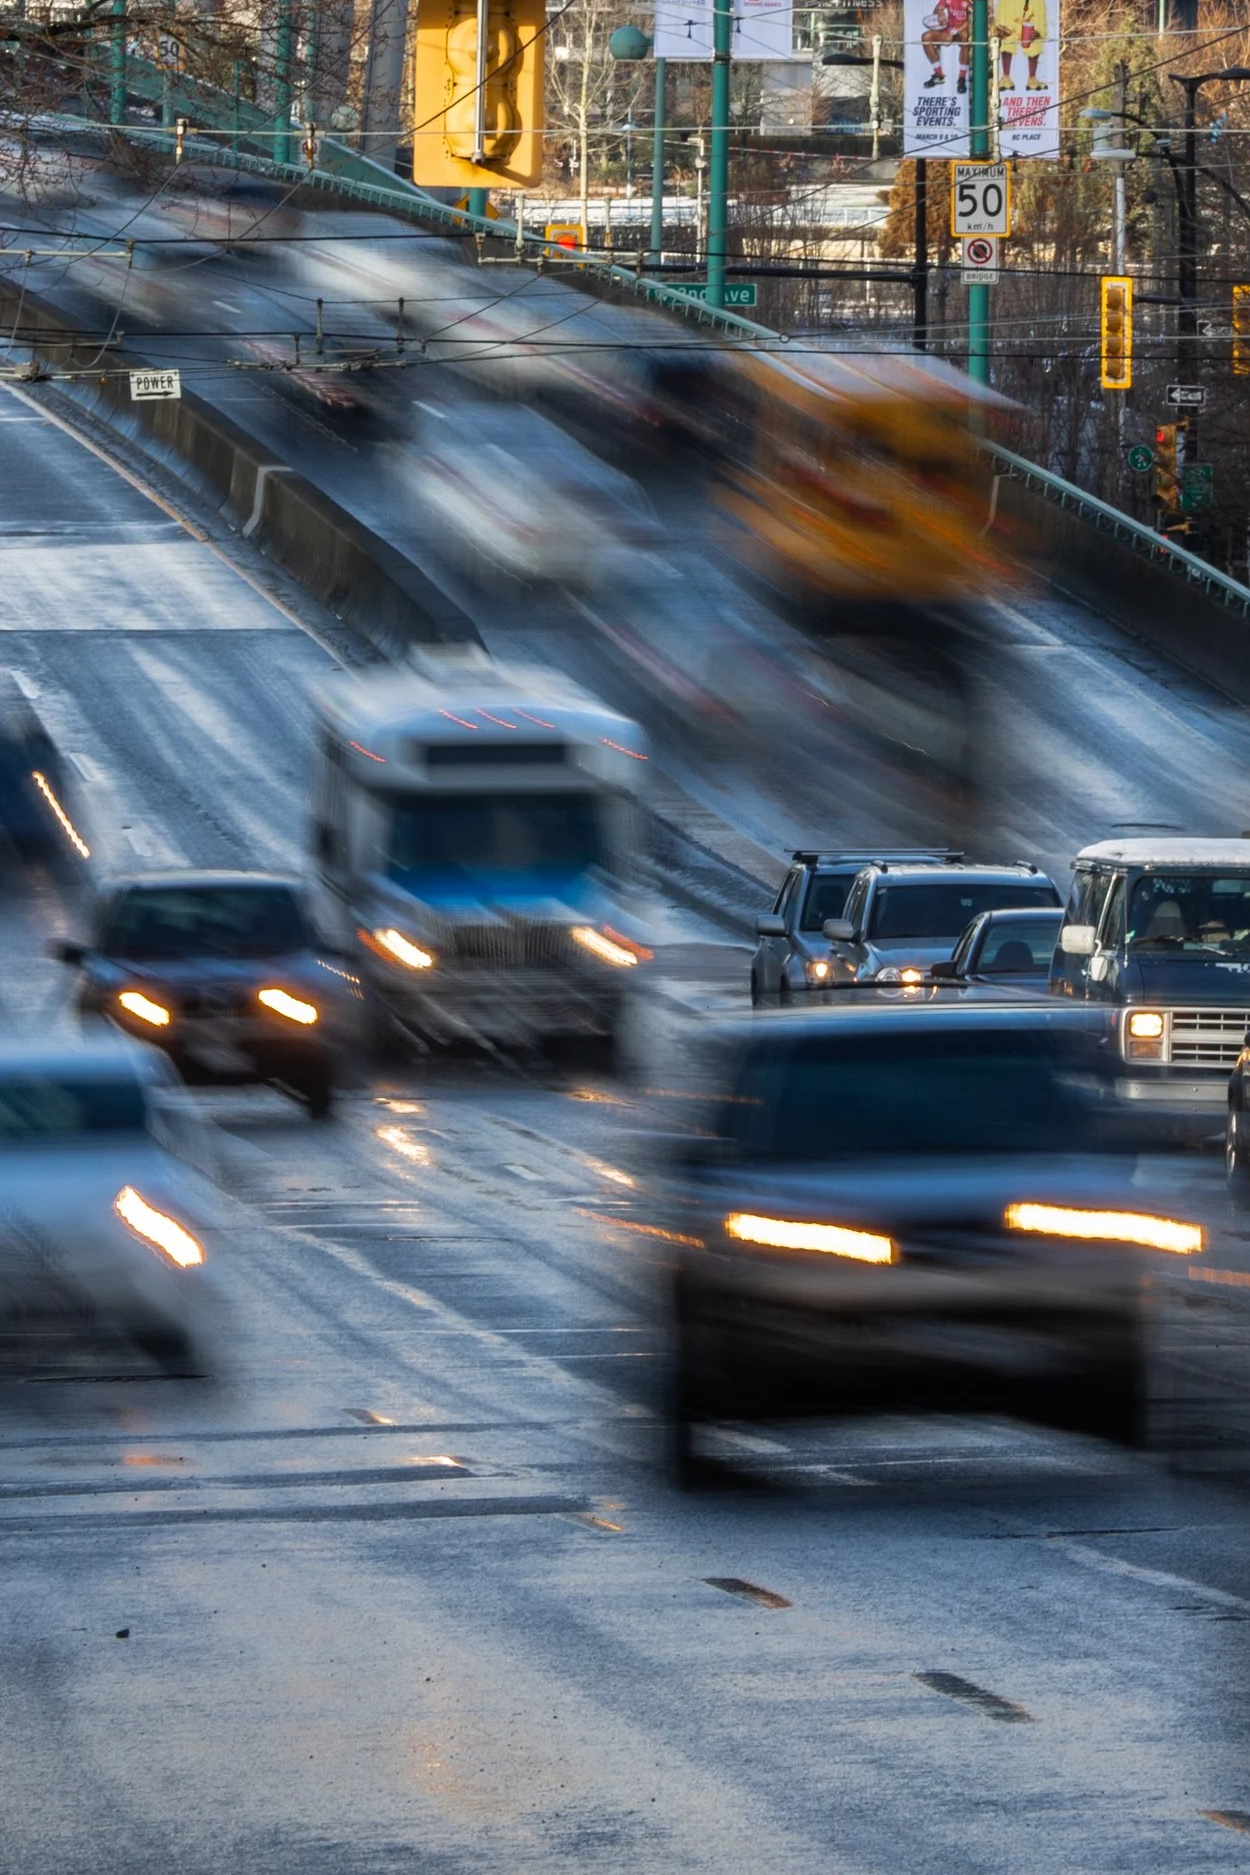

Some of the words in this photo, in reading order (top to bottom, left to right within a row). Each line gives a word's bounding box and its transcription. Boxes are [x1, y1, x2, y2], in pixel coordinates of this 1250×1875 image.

[159, 41, 179, 57] 50
[917, 96, 957, 107] THERE'S
[1003, 96, 1023, 106] AND
[1026, 96, 1051, 106] THEN
[912, 106, 961, 117] SPORTING
[1007, 106, 1047, 117] THERE'S
[916, 116, 957, 126] EVENTS.
[1012, 133, 1020, 141] BC
[1021, 133, 1042, 141] PLACE
[957, 167, 1005, 178] MAXIMUM
[958, 183, 1003, 217] 50
[967, 222, 994, 230] km/h
[136, 376, 173, 390] POWER
